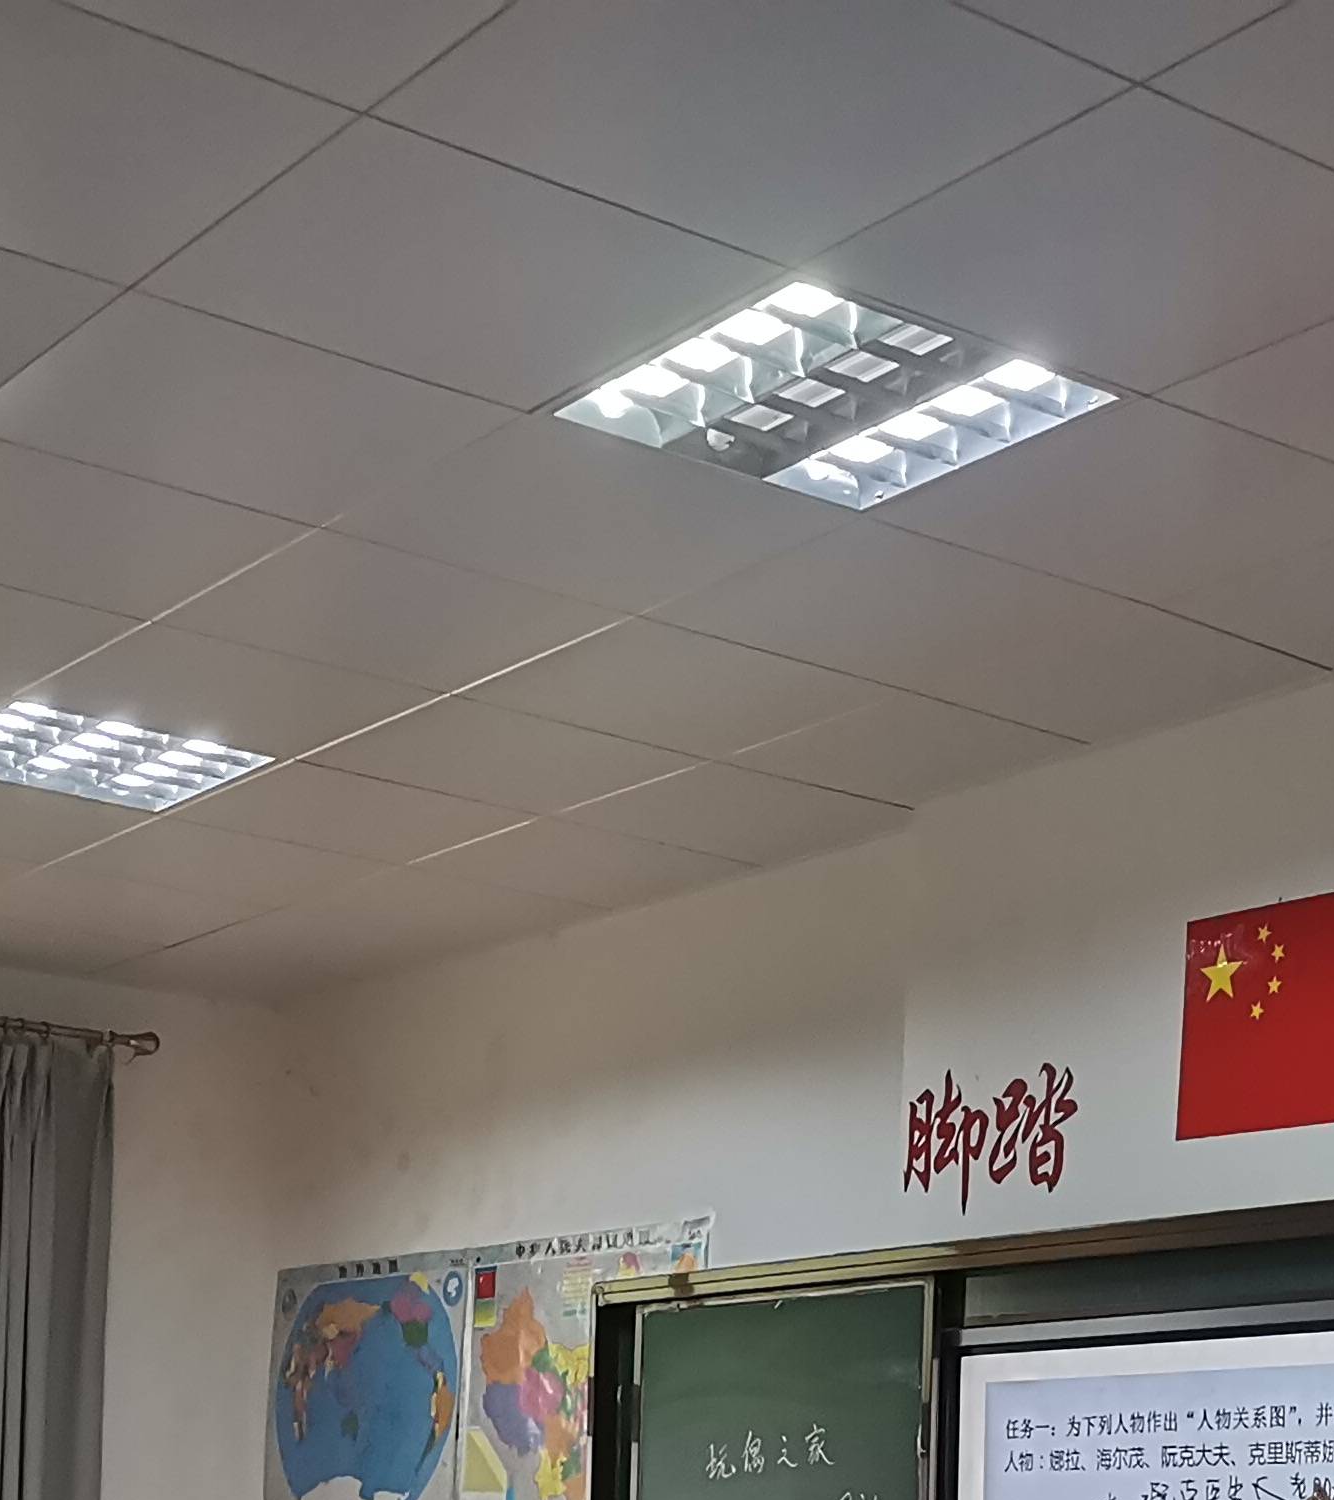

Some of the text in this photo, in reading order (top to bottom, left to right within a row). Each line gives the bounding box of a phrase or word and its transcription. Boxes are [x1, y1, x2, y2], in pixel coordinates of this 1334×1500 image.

[903, 1063, 1076, 1214] 脚踏
[705, 1423, 835, 1479] 玩偶之家
